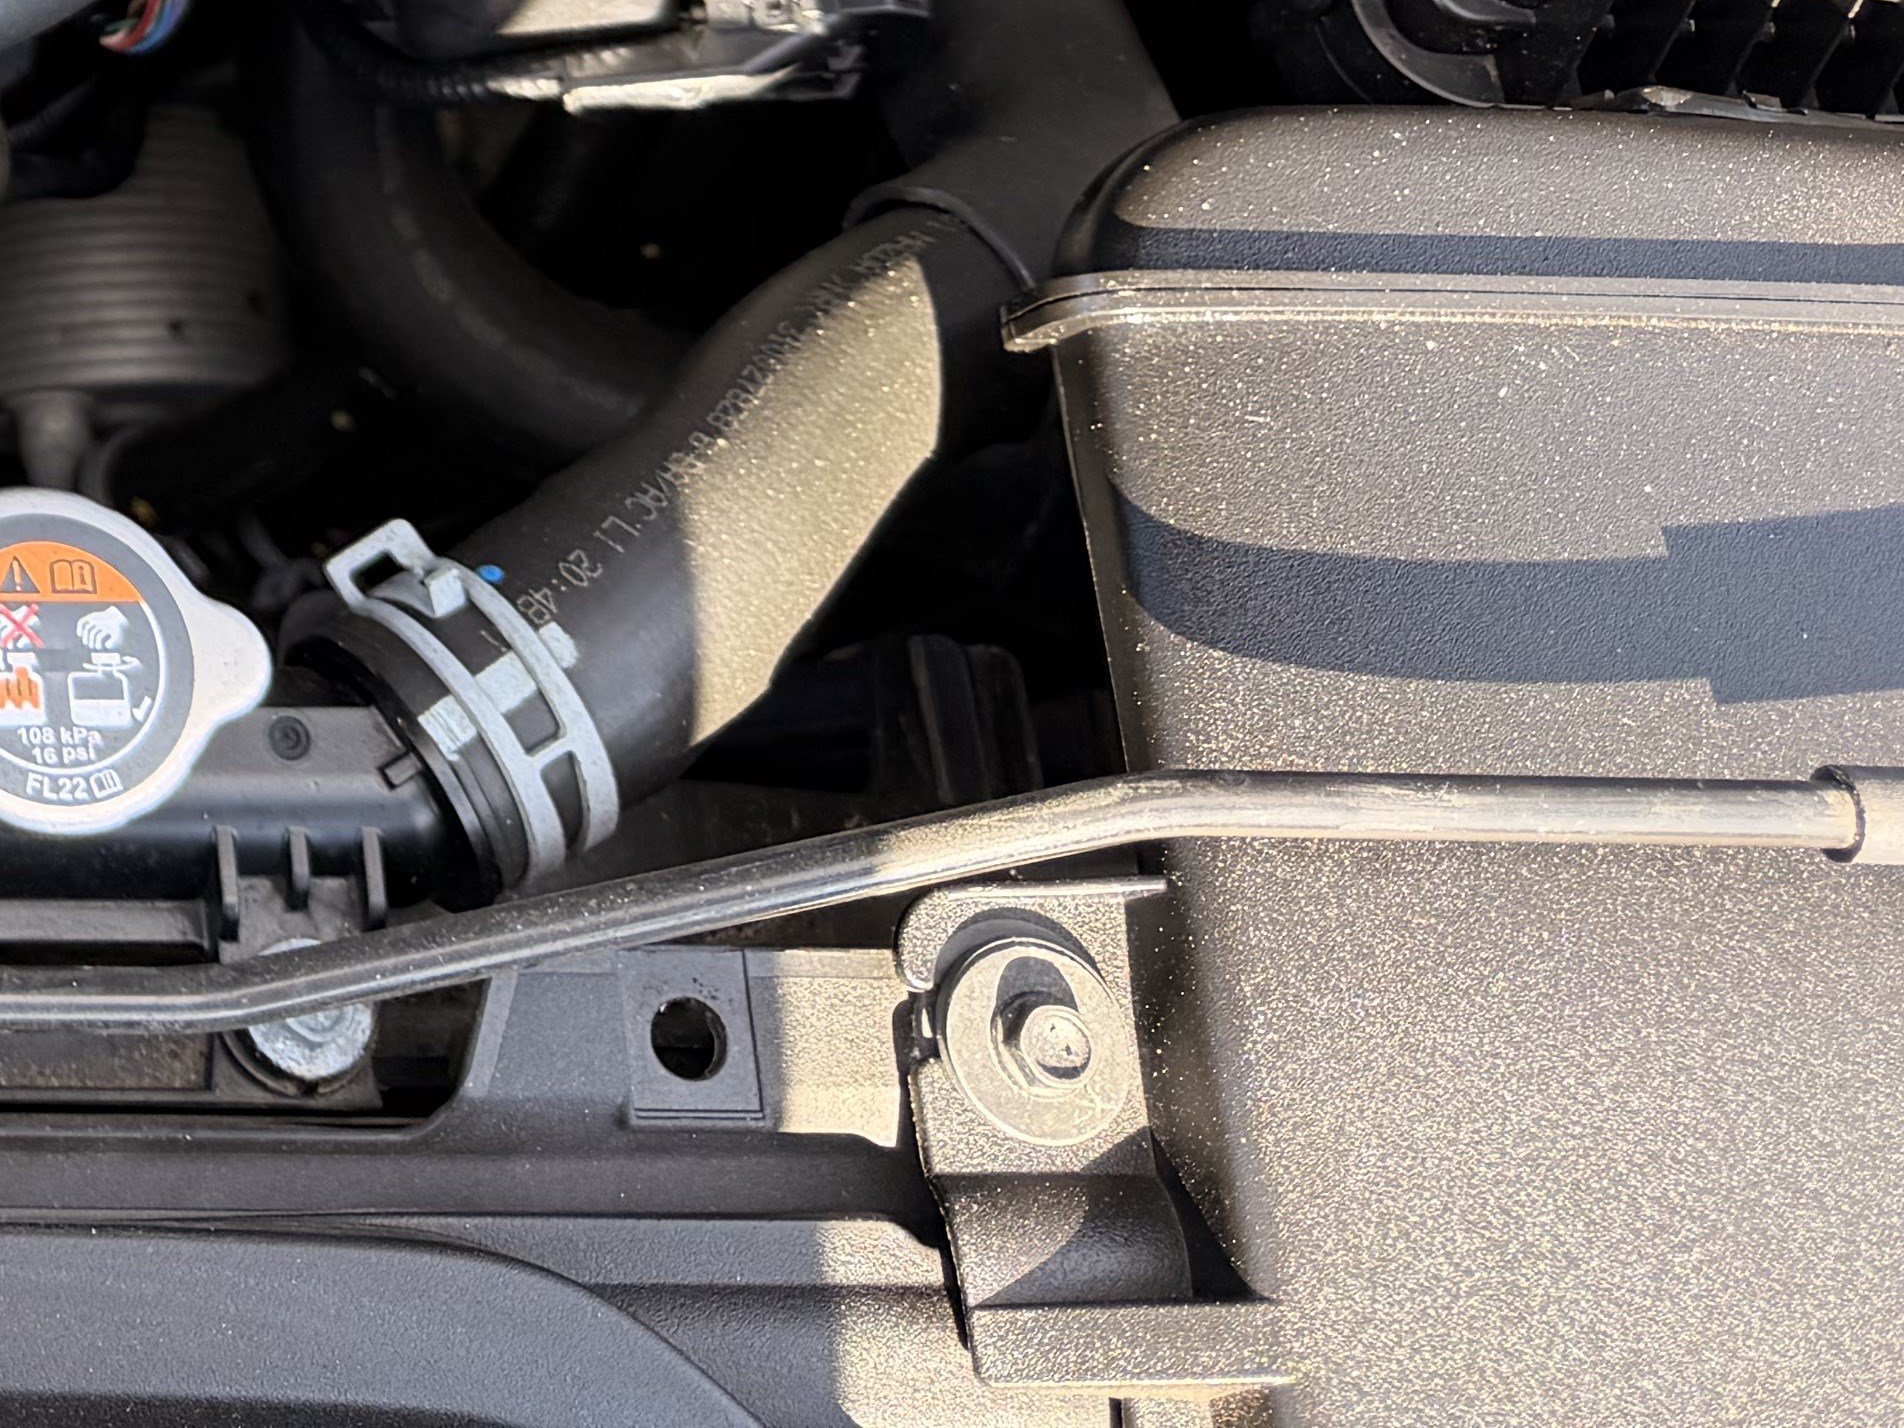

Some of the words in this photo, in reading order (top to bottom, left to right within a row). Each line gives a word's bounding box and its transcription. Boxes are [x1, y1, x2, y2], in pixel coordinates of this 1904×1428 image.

[17, 725, 56, 747] 108
[59, 726, 104, 747] kPa
[31, 745, 59, 765] 16
[61, 744, 98, 765] psi
[25, 770, 90, 802] FL22
